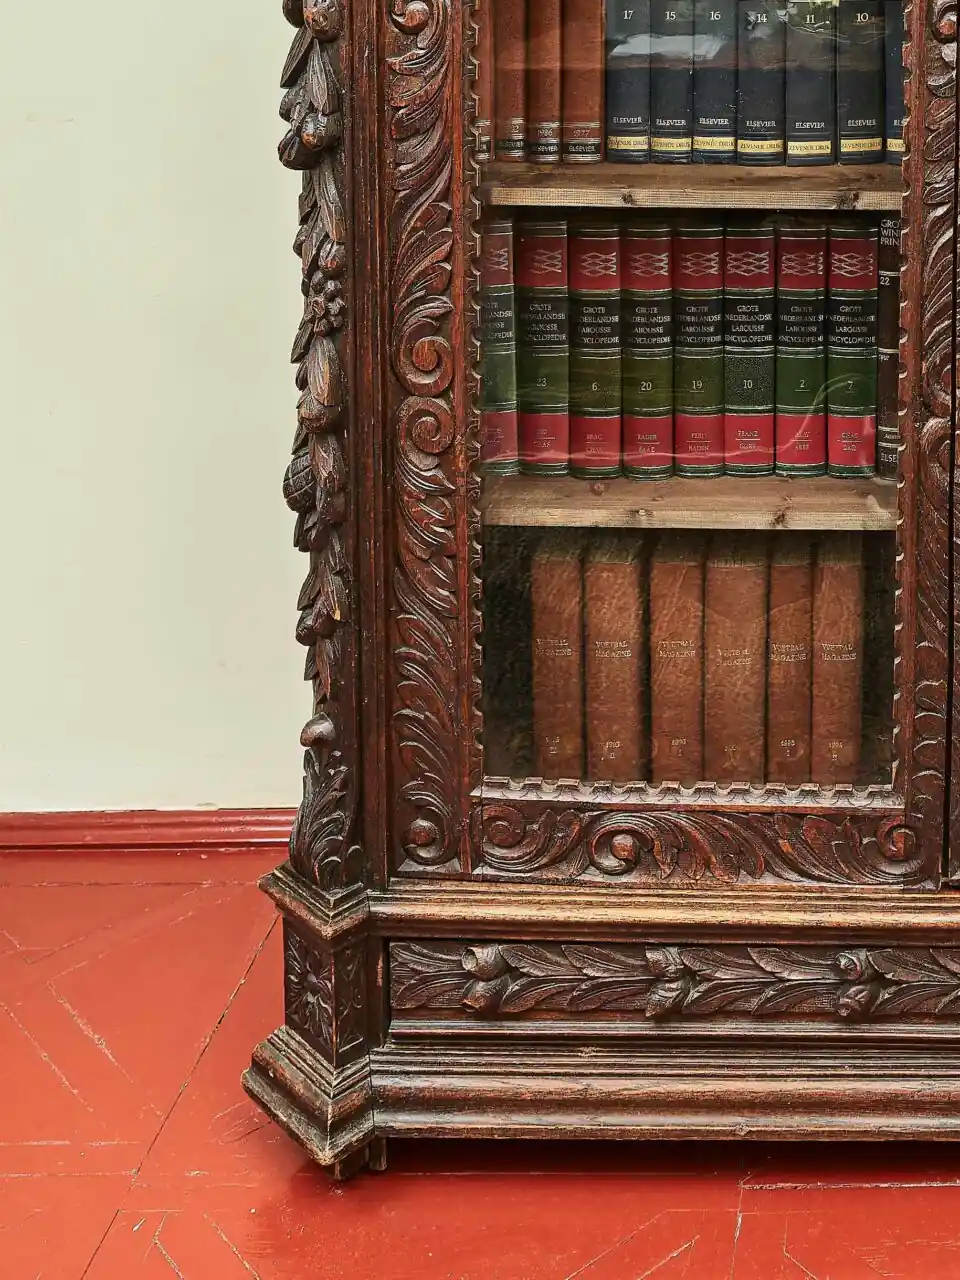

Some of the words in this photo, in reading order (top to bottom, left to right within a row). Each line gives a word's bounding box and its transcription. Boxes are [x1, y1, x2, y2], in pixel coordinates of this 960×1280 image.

[623, 10, 633, 19] 17
[665, 11, 676, 20] 15
[710, 11, 721, 20] 16
[757, 13, 767, 22] 14
[805, 15, 815, 23] 11
[856, 13, 869, 22] 10
[613, 116, 642, 124] ELSEVIER
[795, 121, 825, 129] ELSEVIER
[880, 276, 890, 286] 22
[640, 381, 652, 391] 20
[692, 380, 702, 389] 19
[743, 379, 753, 389] 10
